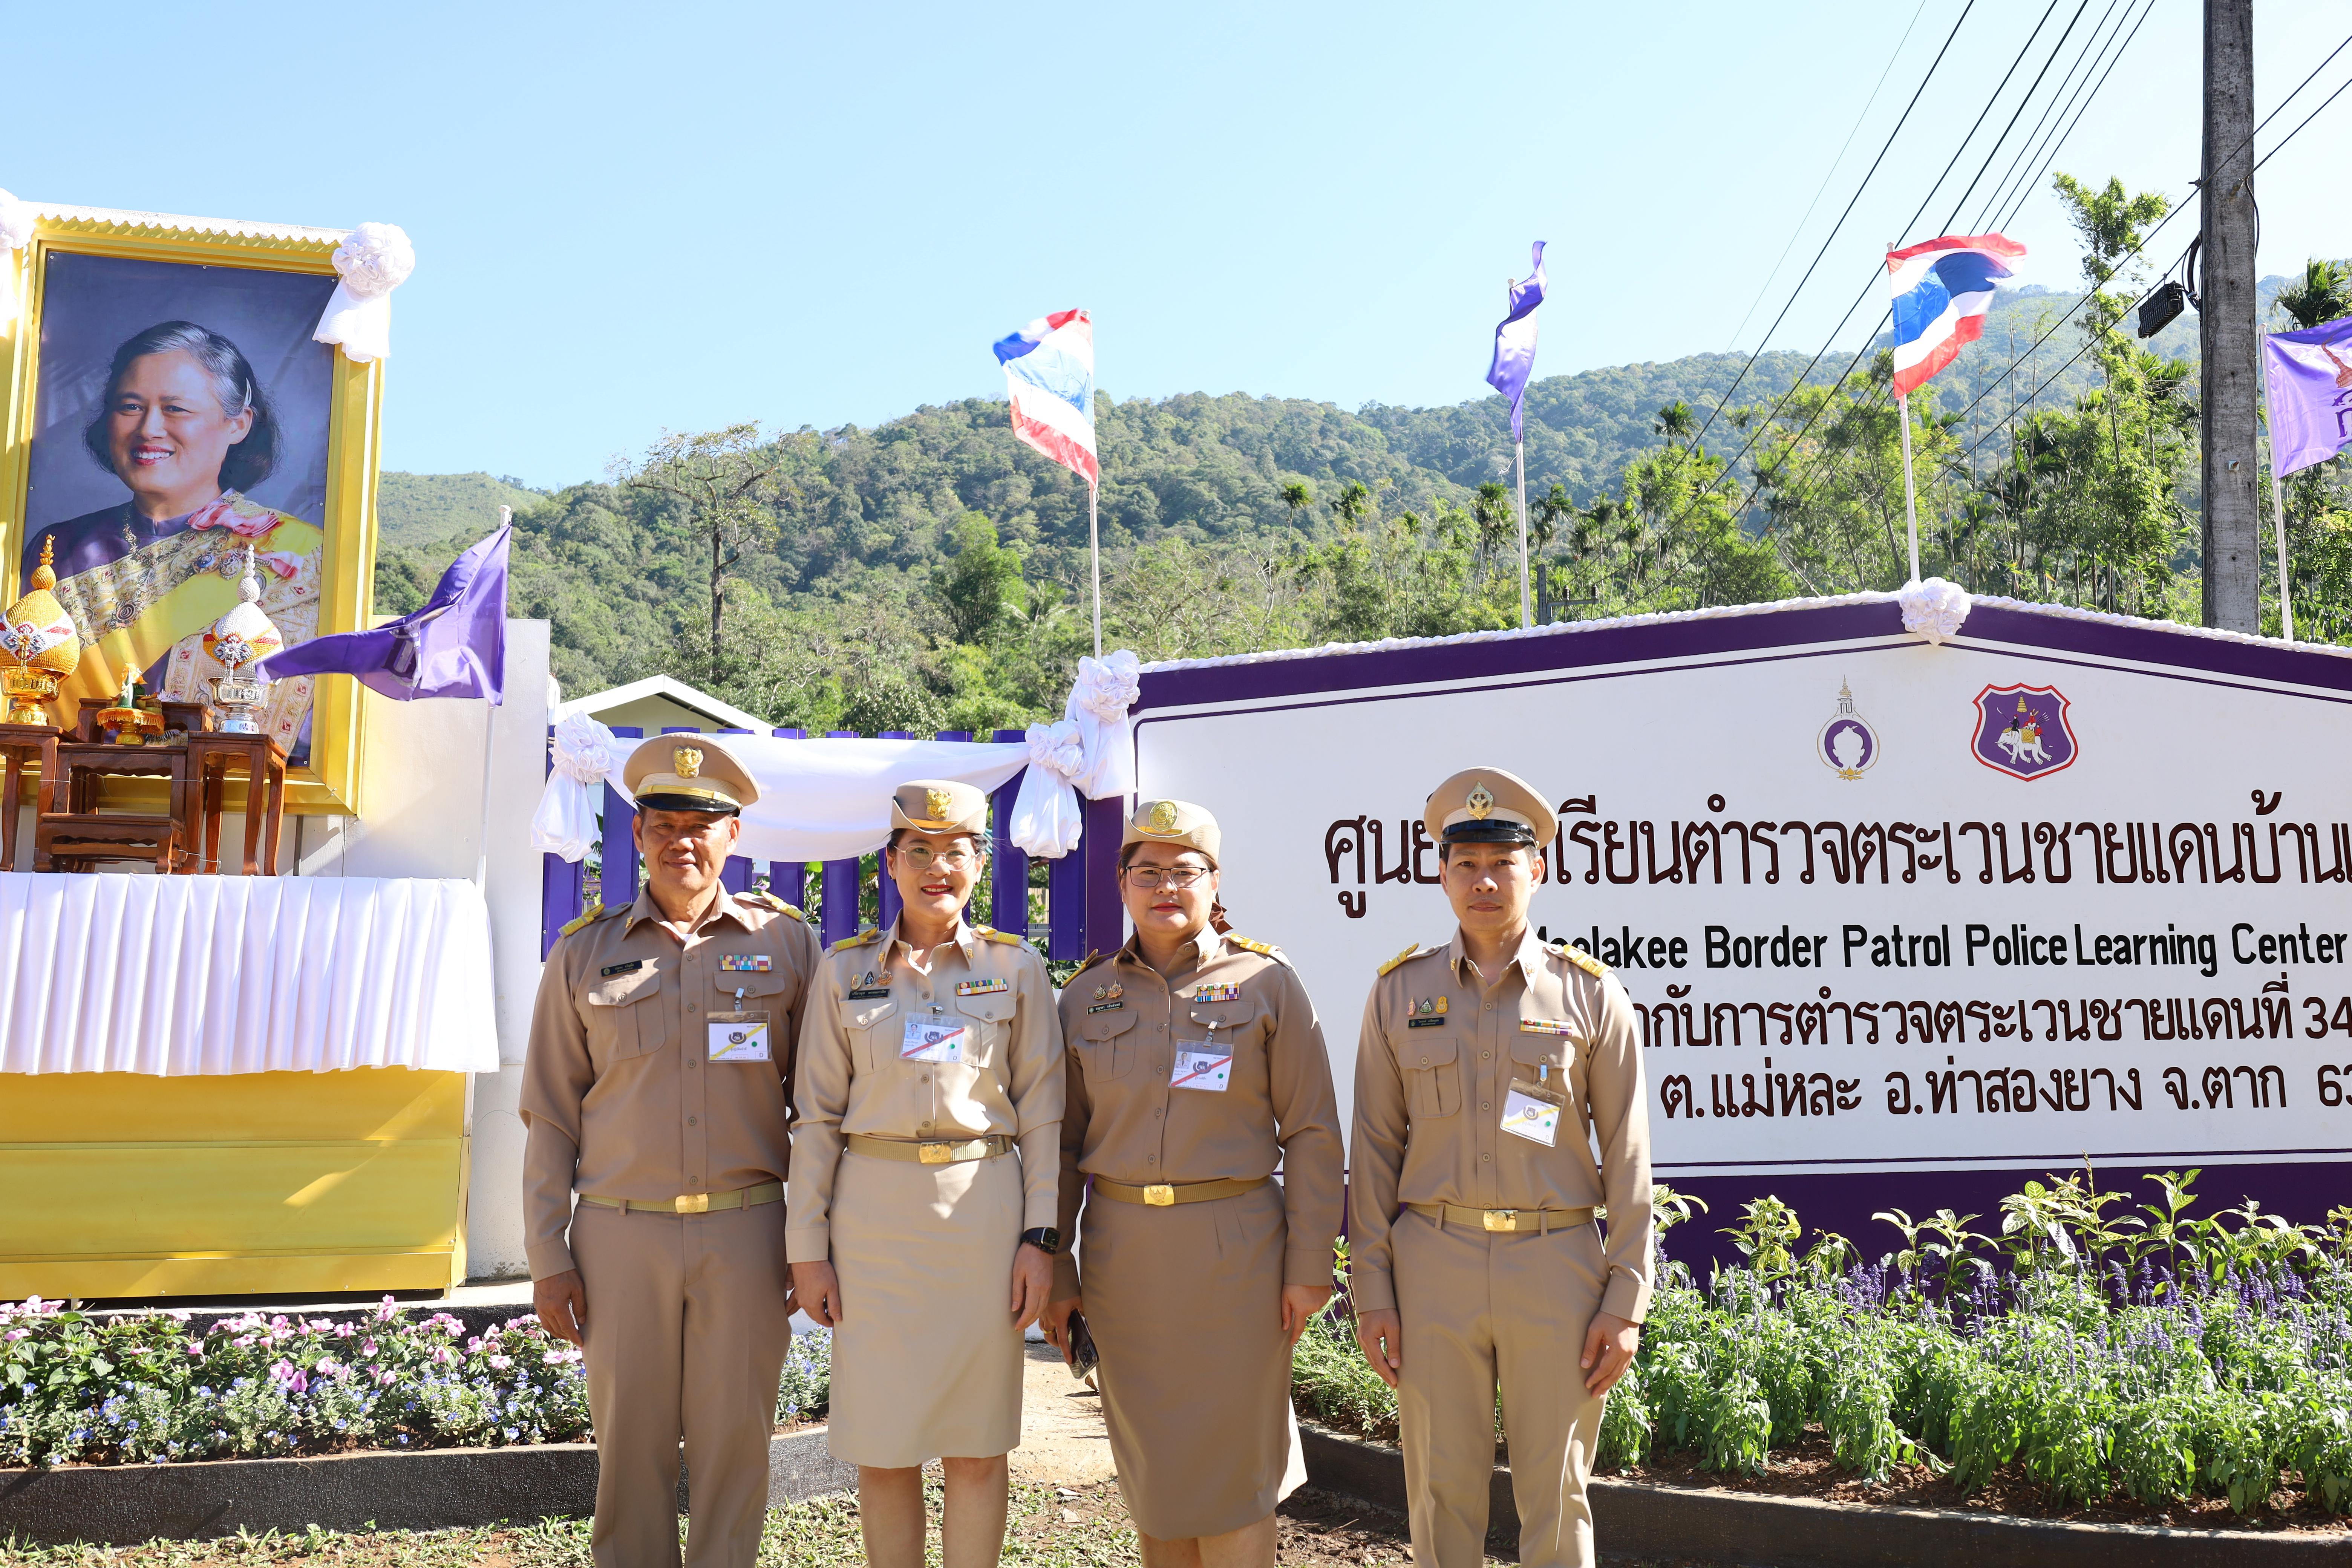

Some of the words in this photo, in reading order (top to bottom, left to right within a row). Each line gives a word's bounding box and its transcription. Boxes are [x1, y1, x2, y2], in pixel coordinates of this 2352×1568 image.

[1705, 925, 1827, 968] Border
[1843, 924, 1951, 967] Patrol
[1965, 924, 2068, 966] Police
[2074, 923, 2218, 977] Learning
[2232, 923, 2348, 964] Center
[1660, 1057, 1862, 1119] ต.แม่หละ
[1885, 1055, 2142, 1115] อ.ท่าสองยาง
[2162, 1065, 2286, 1110] จ.ตาก
